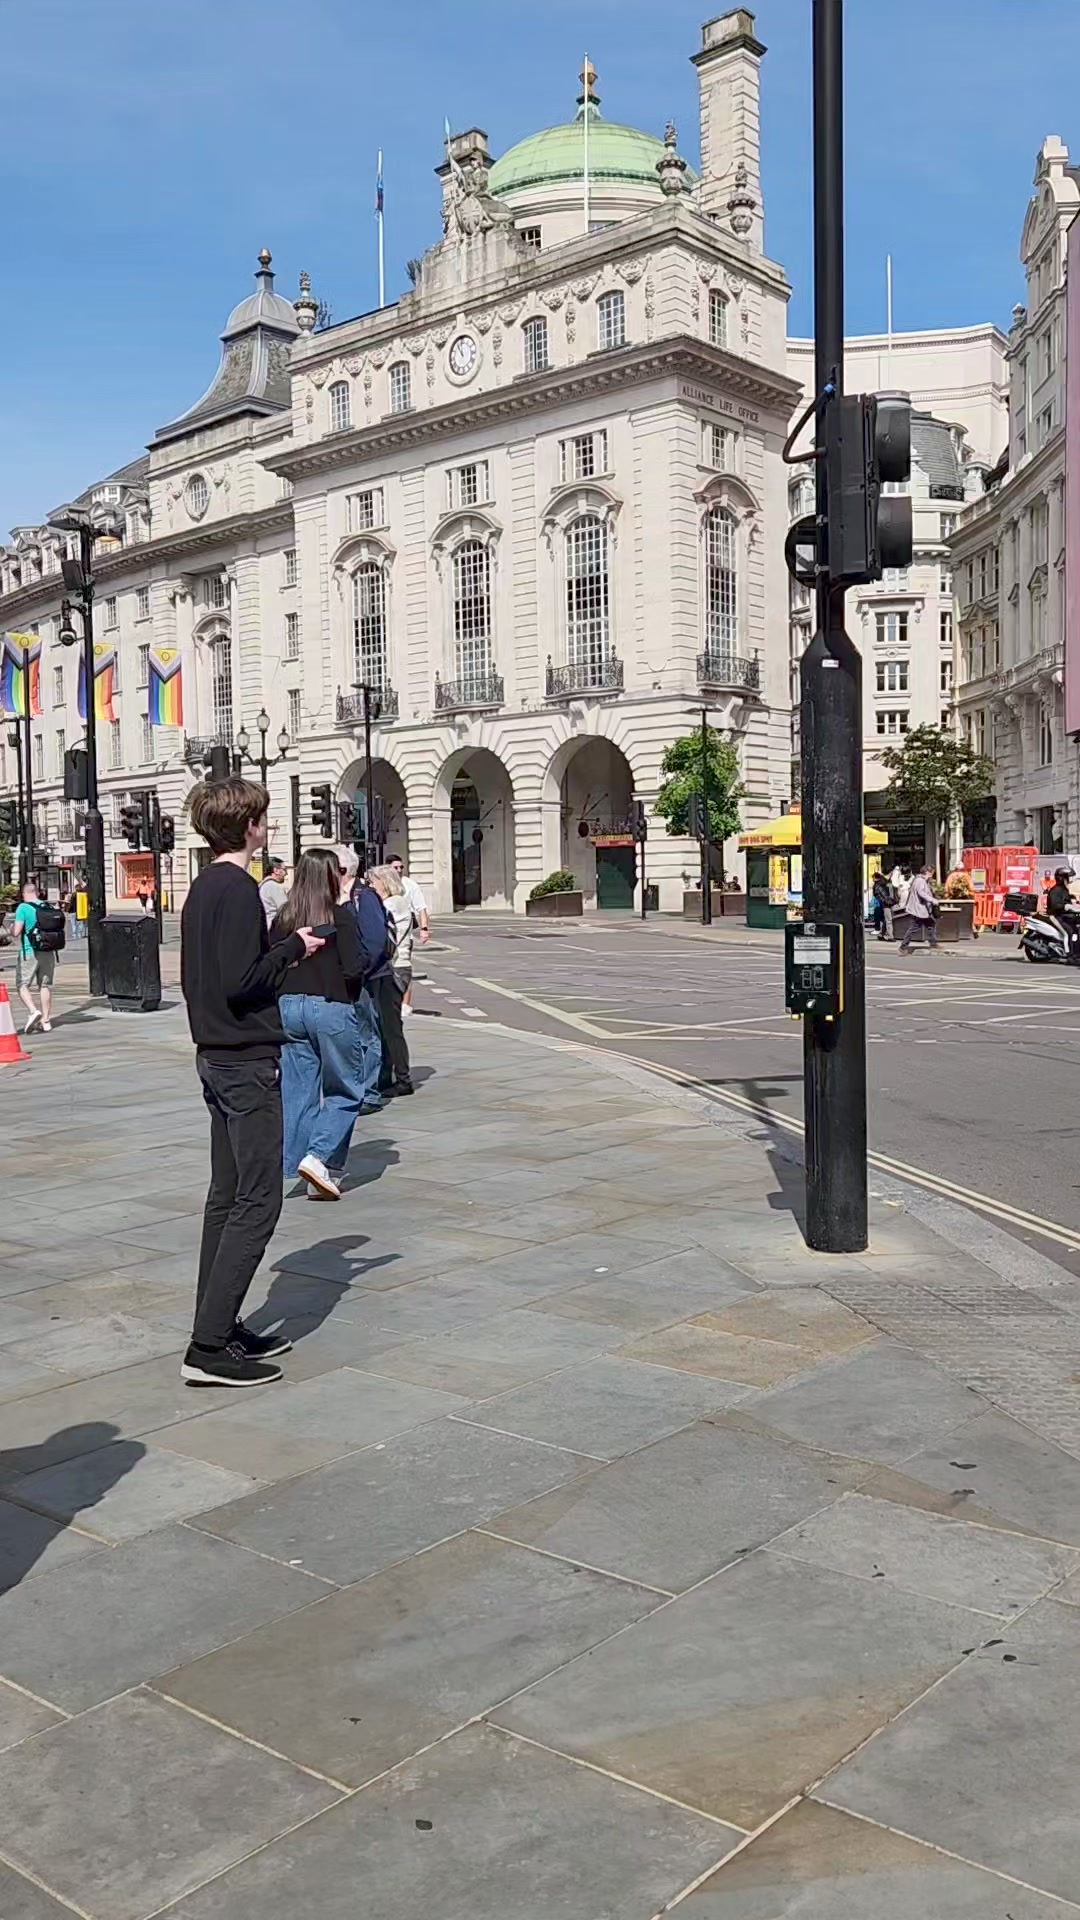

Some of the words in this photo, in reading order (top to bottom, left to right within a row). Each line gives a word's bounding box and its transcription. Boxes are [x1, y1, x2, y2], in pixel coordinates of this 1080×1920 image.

[683, 386, 714, 406] ALLIANCE
[719, 400, 733, 413] LIFE
[738, 407, 760, 423] OFFICE
